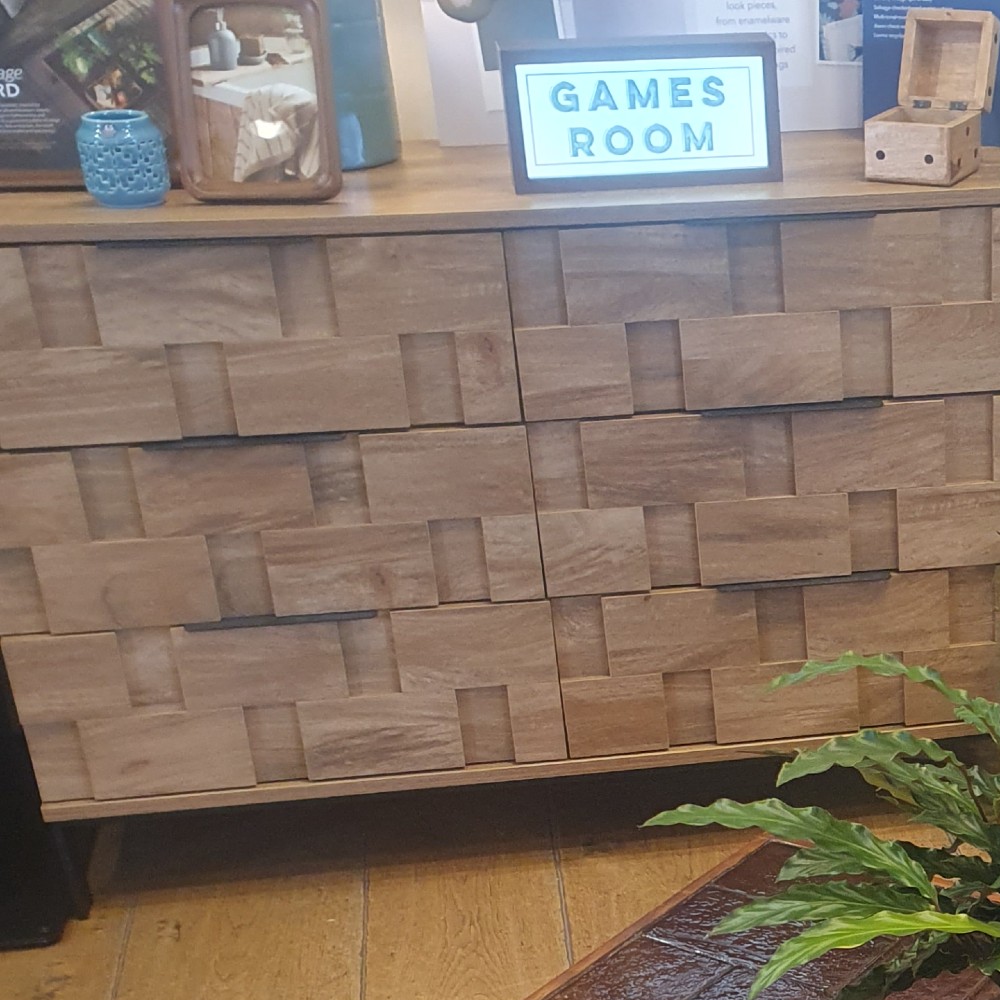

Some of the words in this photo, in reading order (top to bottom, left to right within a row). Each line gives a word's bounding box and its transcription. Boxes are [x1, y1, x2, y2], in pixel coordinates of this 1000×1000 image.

[715, 16, 737, 26] from
[738, 15, 790, 25] enamelware
[550, 75, 726, 112] GAMES
[568, 121, 714, 158] ROOM
